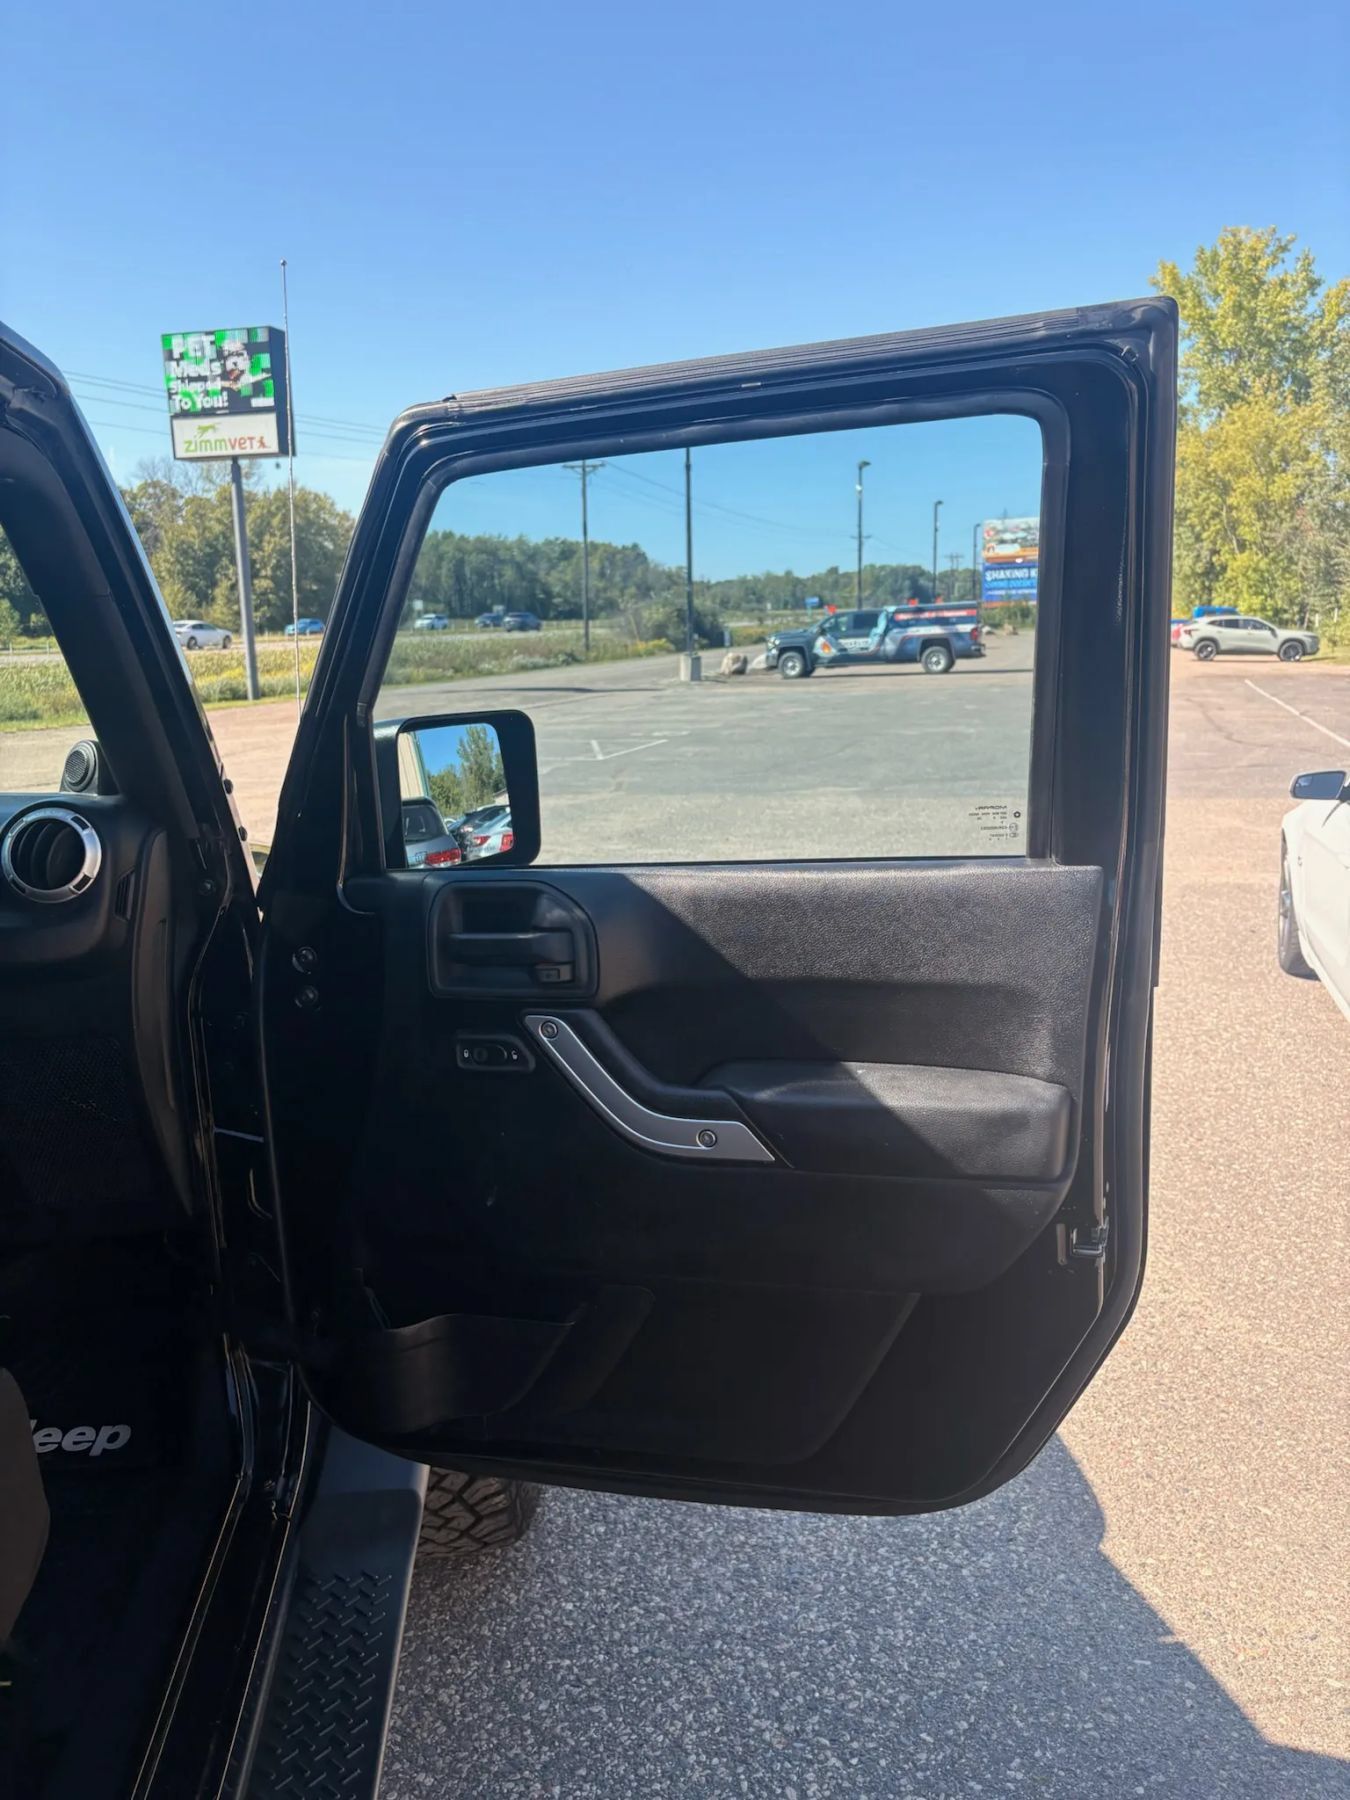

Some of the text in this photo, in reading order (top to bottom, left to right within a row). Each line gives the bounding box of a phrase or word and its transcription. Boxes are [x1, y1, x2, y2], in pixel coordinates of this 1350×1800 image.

[172, 335, 216, 359] PET
[170, 359, 222, 378] Meds
[171, 391, 229, 410] To You!
[30, 1419, 131, 1456] eep
